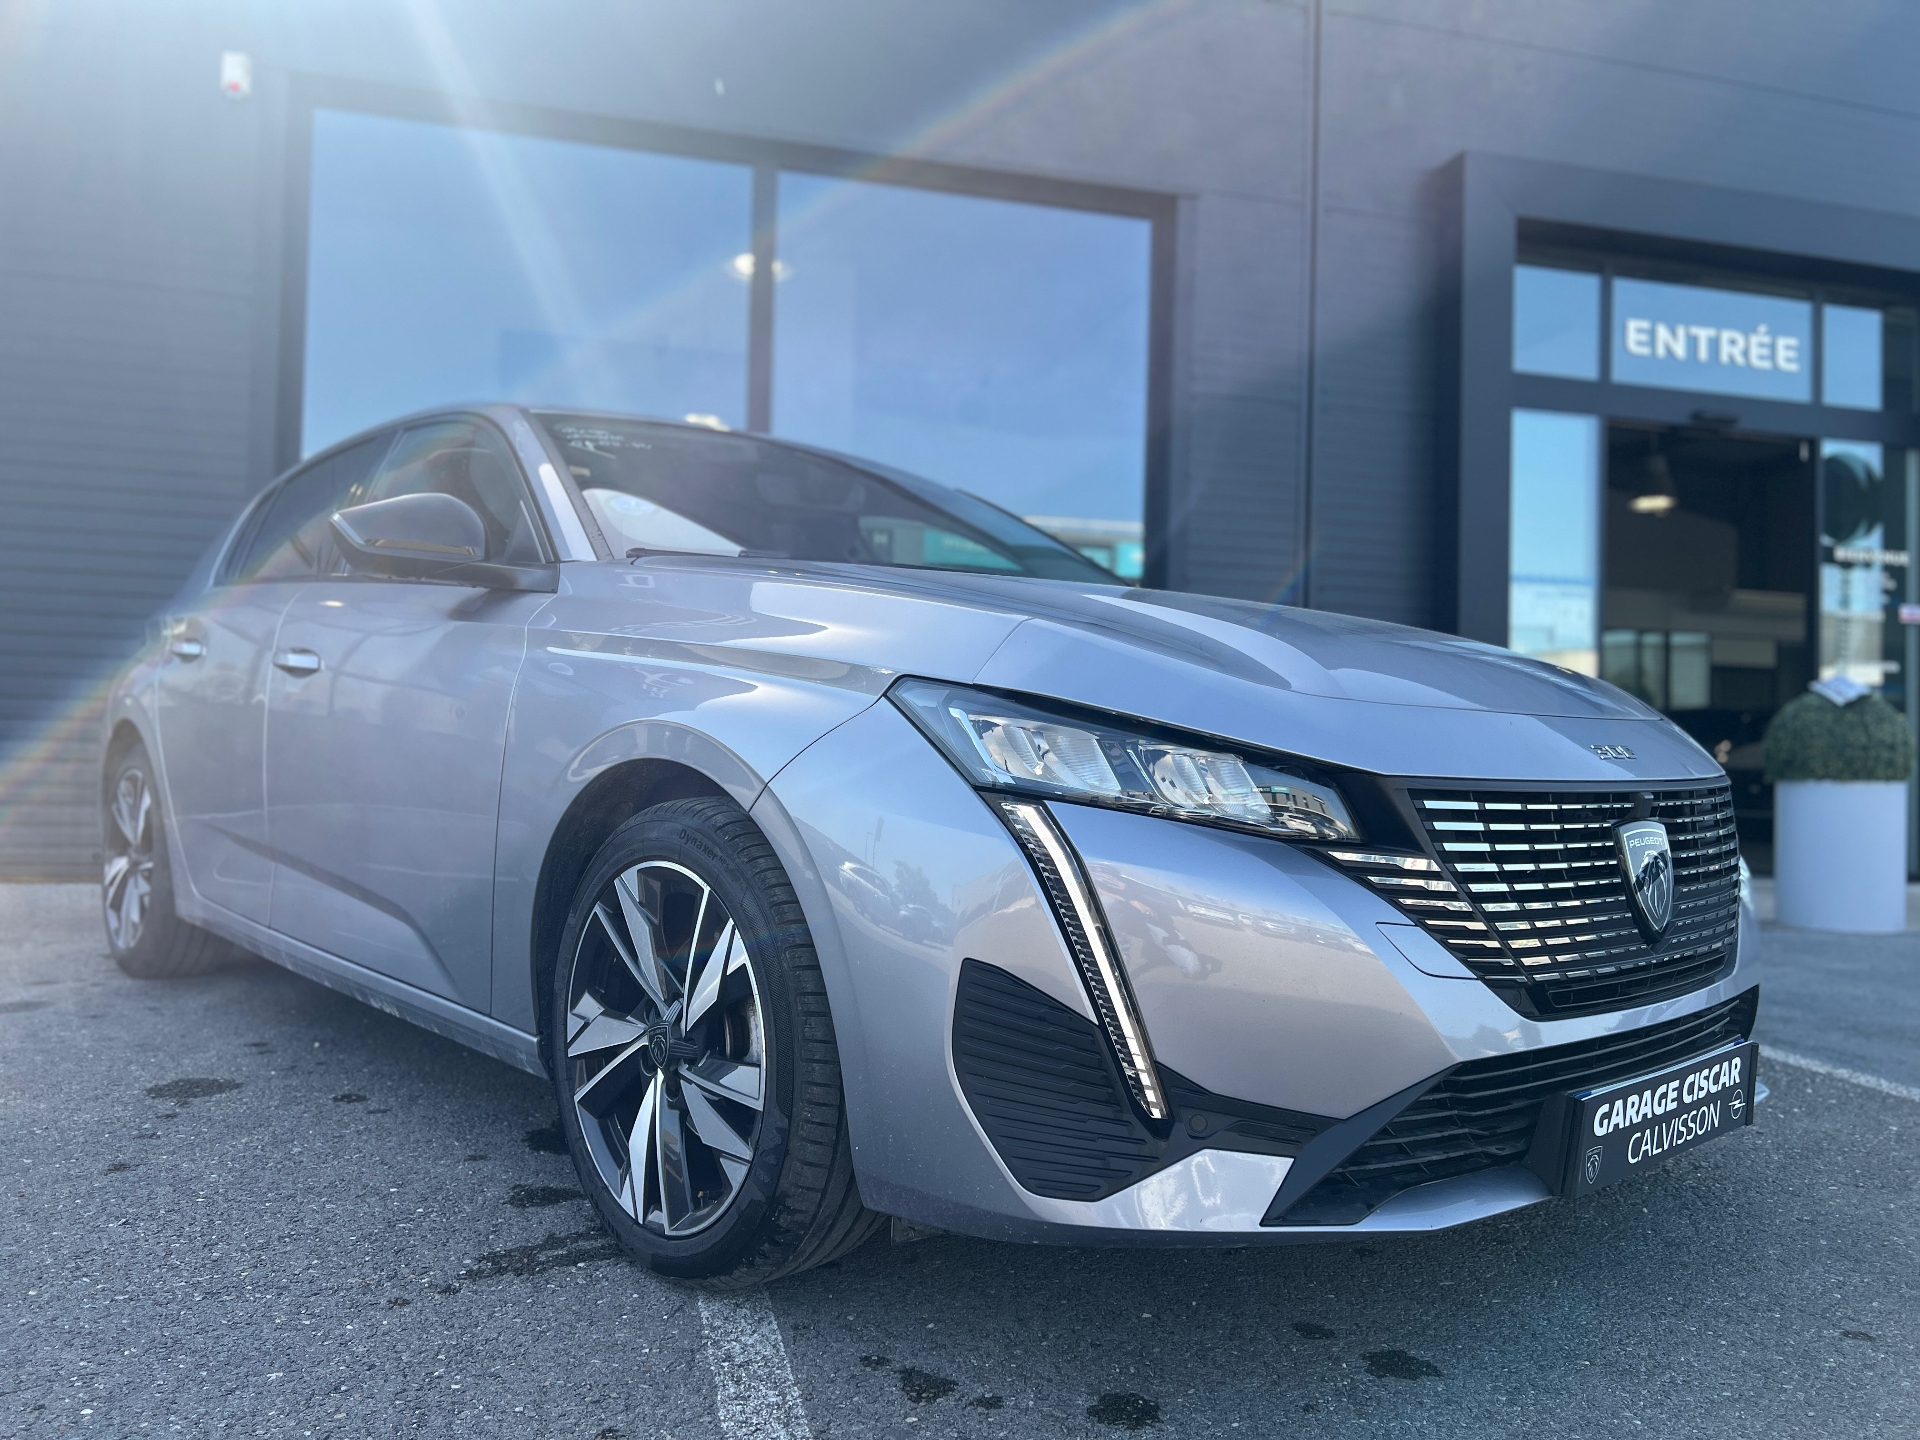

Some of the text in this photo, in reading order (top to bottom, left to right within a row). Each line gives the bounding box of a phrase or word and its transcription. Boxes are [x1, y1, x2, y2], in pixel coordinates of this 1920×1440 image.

[1625, 318, 1800, 372] ENTRÉE
[679, 829, 718, 861] Dynaxer
[1629, 836, 1664, 849] PEUGEOT
[1593, 1056, 1742, 1137] GARAGE CISCAR
[1627, 1100, 1721, 1164] CALVISSON
